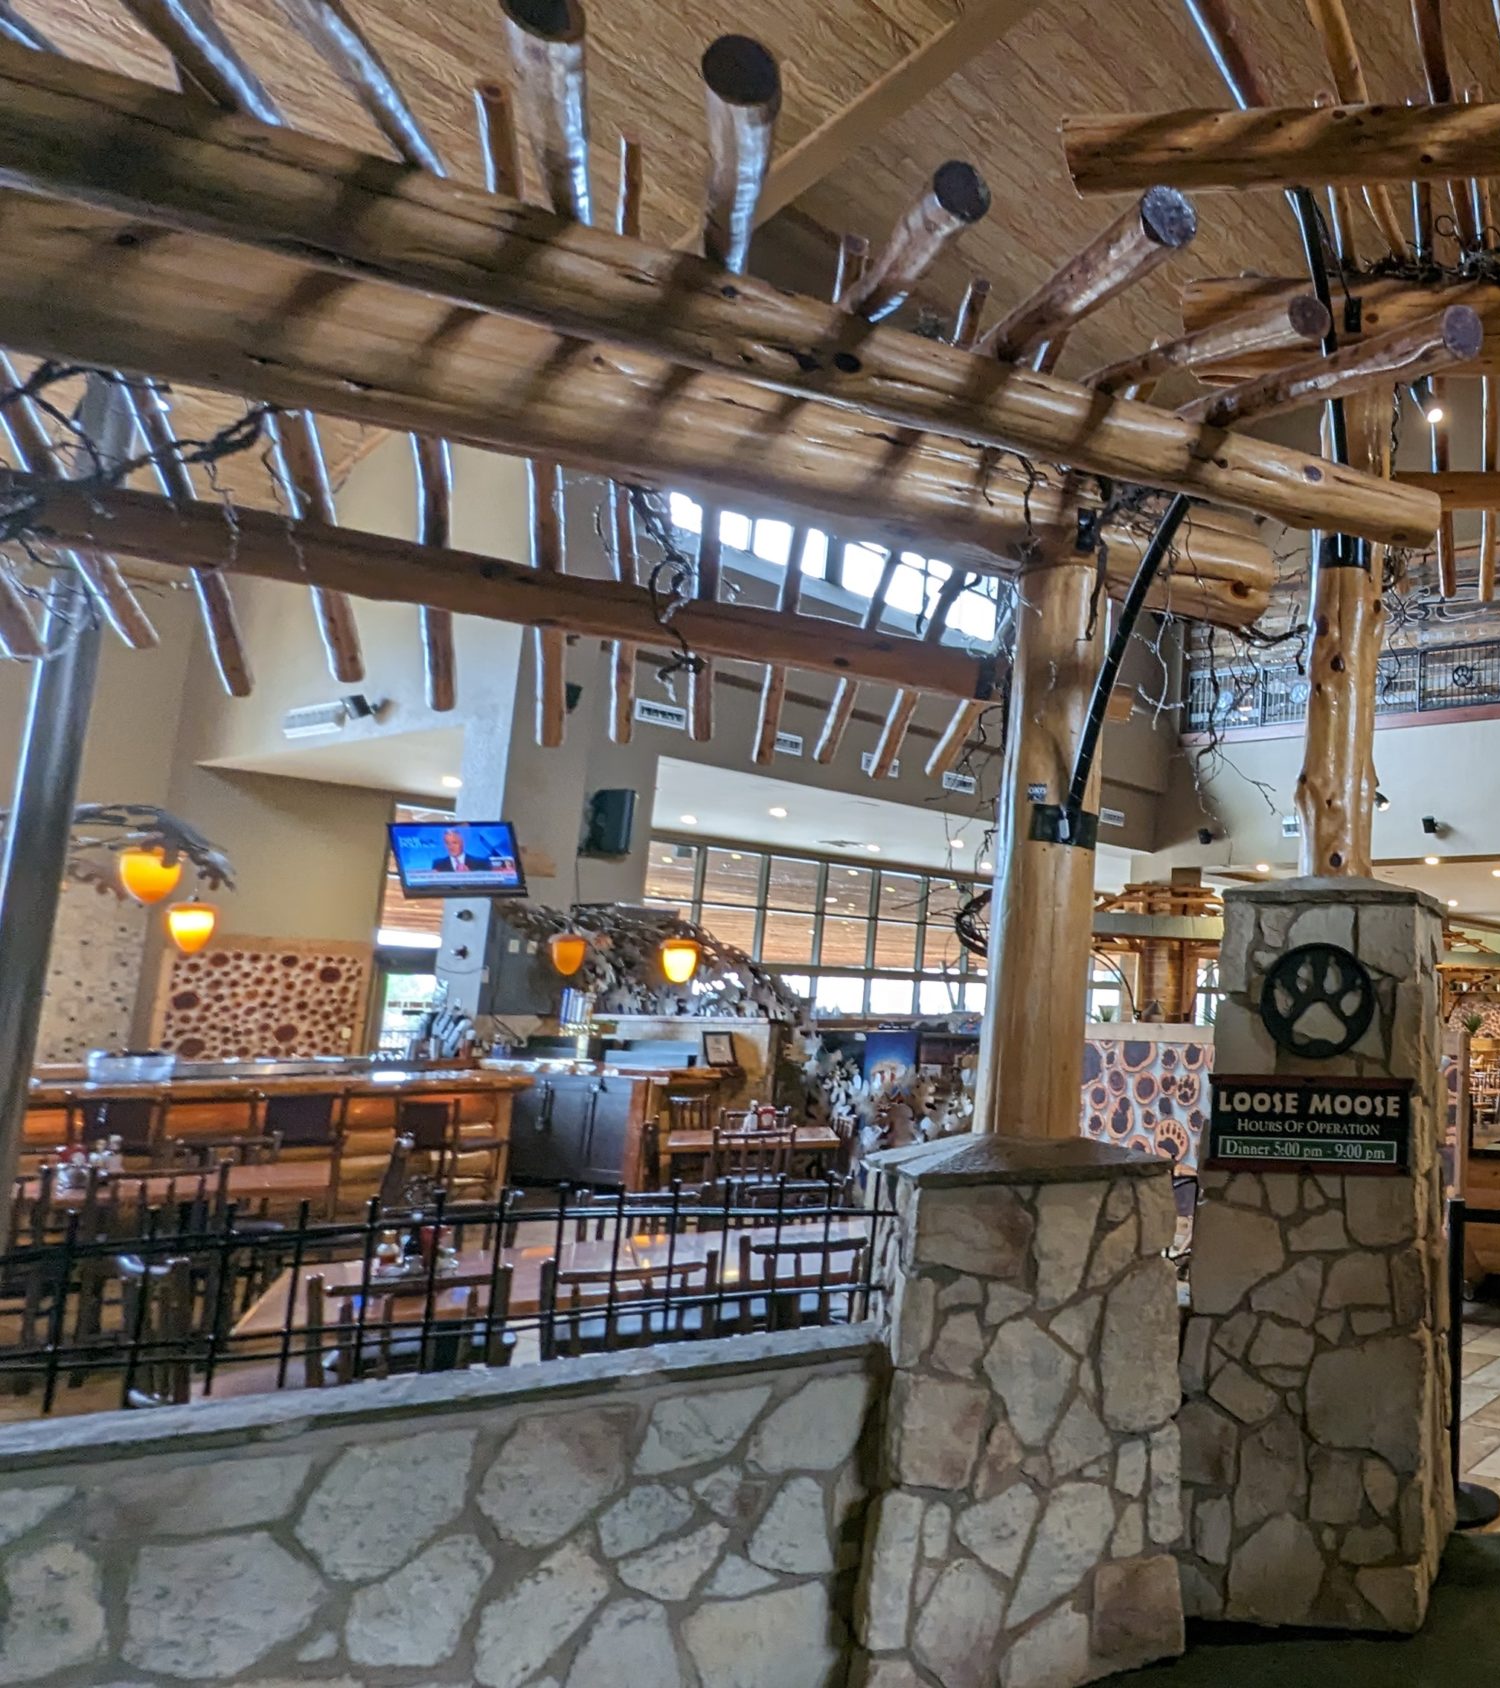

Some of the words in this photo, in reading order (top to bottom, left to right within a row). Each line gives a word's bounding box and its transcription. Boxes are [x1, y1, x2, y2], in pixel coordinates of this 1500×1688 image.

[1219, 1091, 1299, 1114] LOOSE
[1308, 1093, 1401, 1117] MOOSE
[1237, 1118, 1283, 1132] HOURS
[1284, 1120, 1305, 1133] OF
[1306, 1120, 1381, 1136] OPERATION
[1225, 1139, 1271, 1155] Dinner
[1273, 1141, 1300, 1157] 5:00
[1303, 1146, 1323, 1159] pm
[1334, 1143, 1363, 1159] 9:00
[1365, 1149, 1386, 1160] pm
